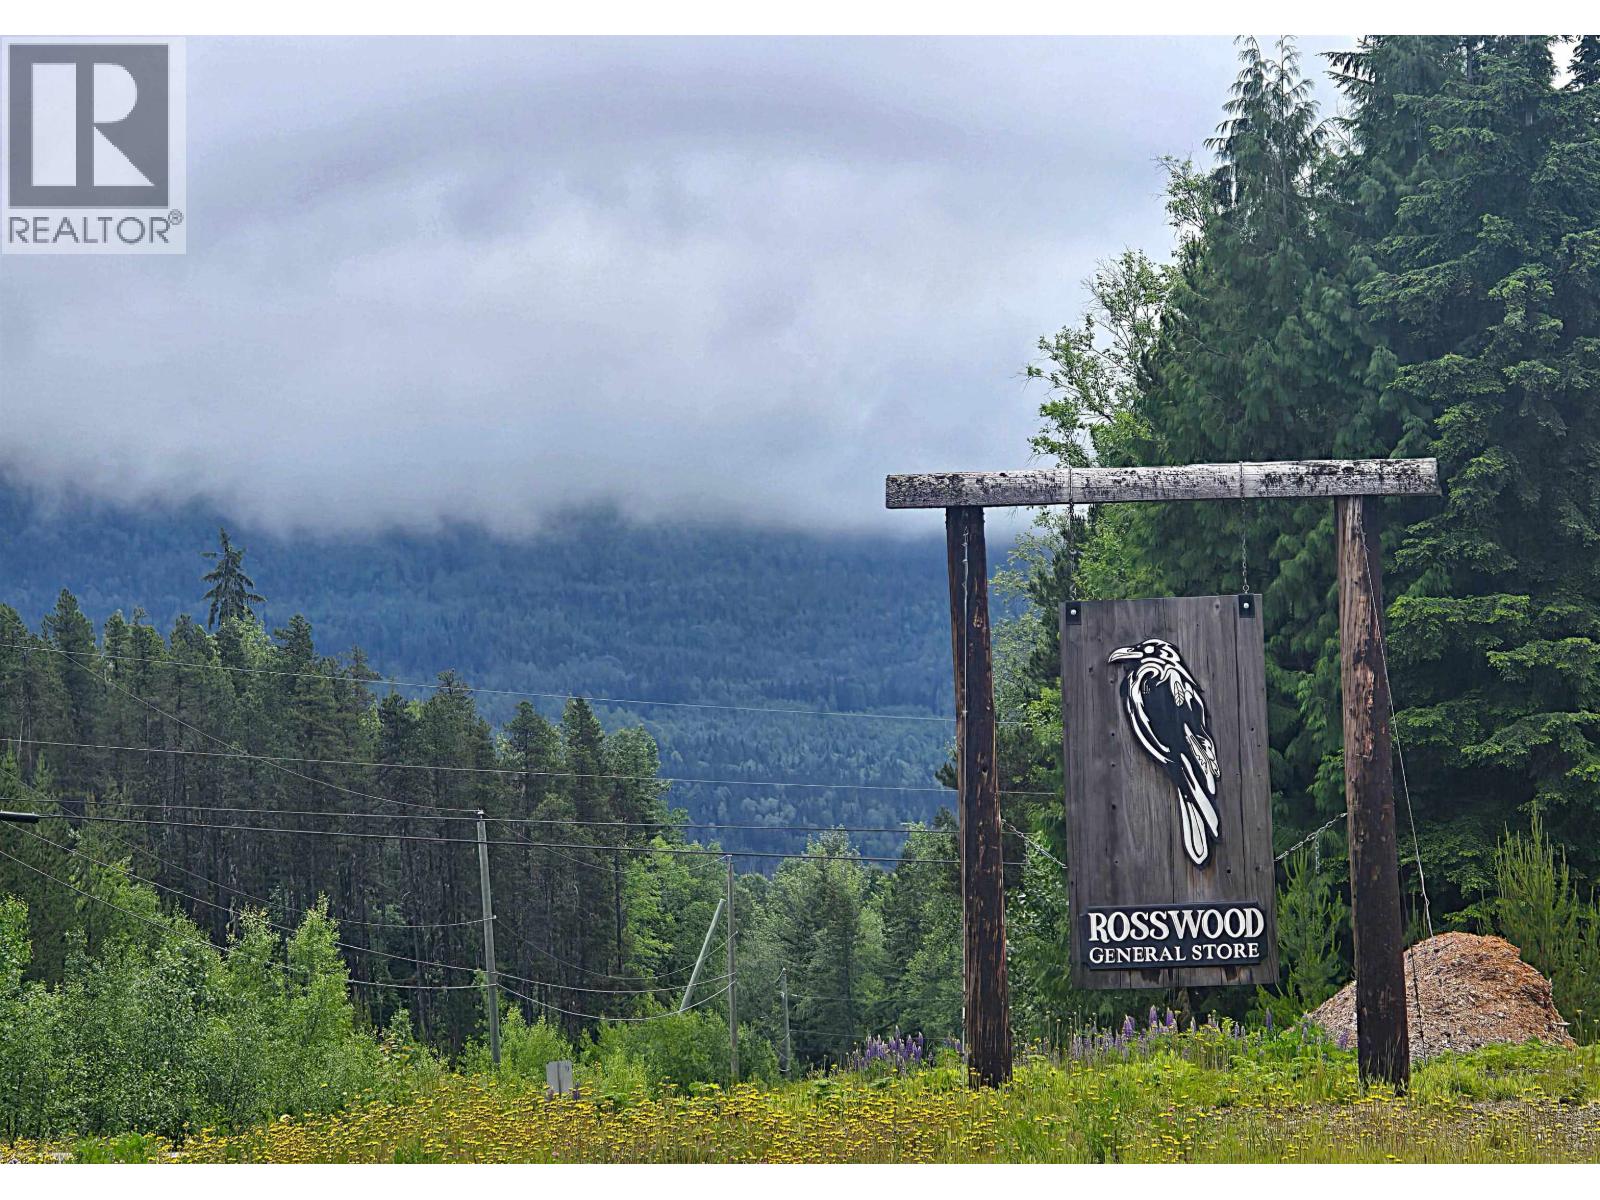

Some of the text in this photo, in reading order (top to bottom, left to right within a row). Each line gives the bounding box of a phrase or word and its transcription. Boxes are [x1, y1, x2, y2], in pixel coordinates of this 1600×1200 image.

[1088, 907, 1265, 943] ROSSWOOD
[1089, 943, 1260, 964] GENERAL STORE
